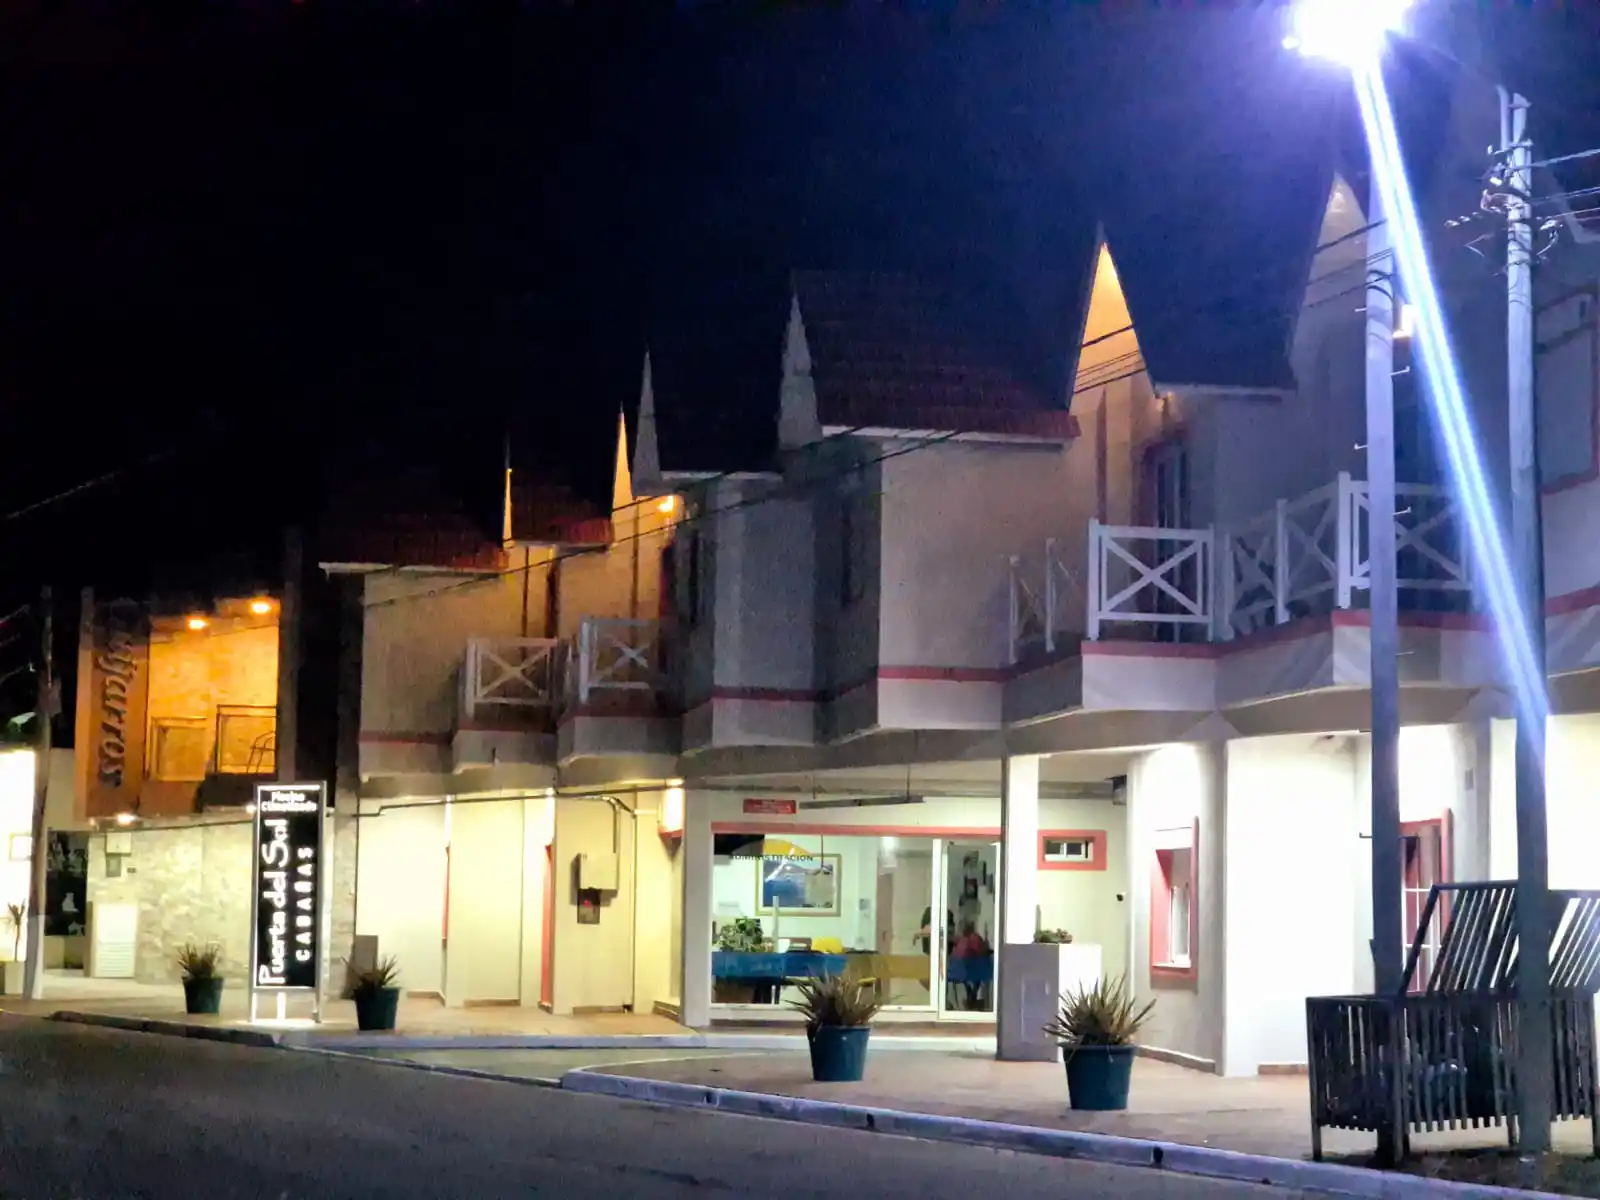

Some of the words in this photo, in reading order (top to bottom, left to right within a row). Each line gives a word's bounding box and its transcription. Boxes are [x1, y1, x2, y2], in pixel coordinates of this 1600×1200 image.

[261, 818, 288, 868] Sol
[263, 872, 286, 908] del
[293, 847, 314, 962] CABAÑAS
[258, 911, 286, 984] Puerta
